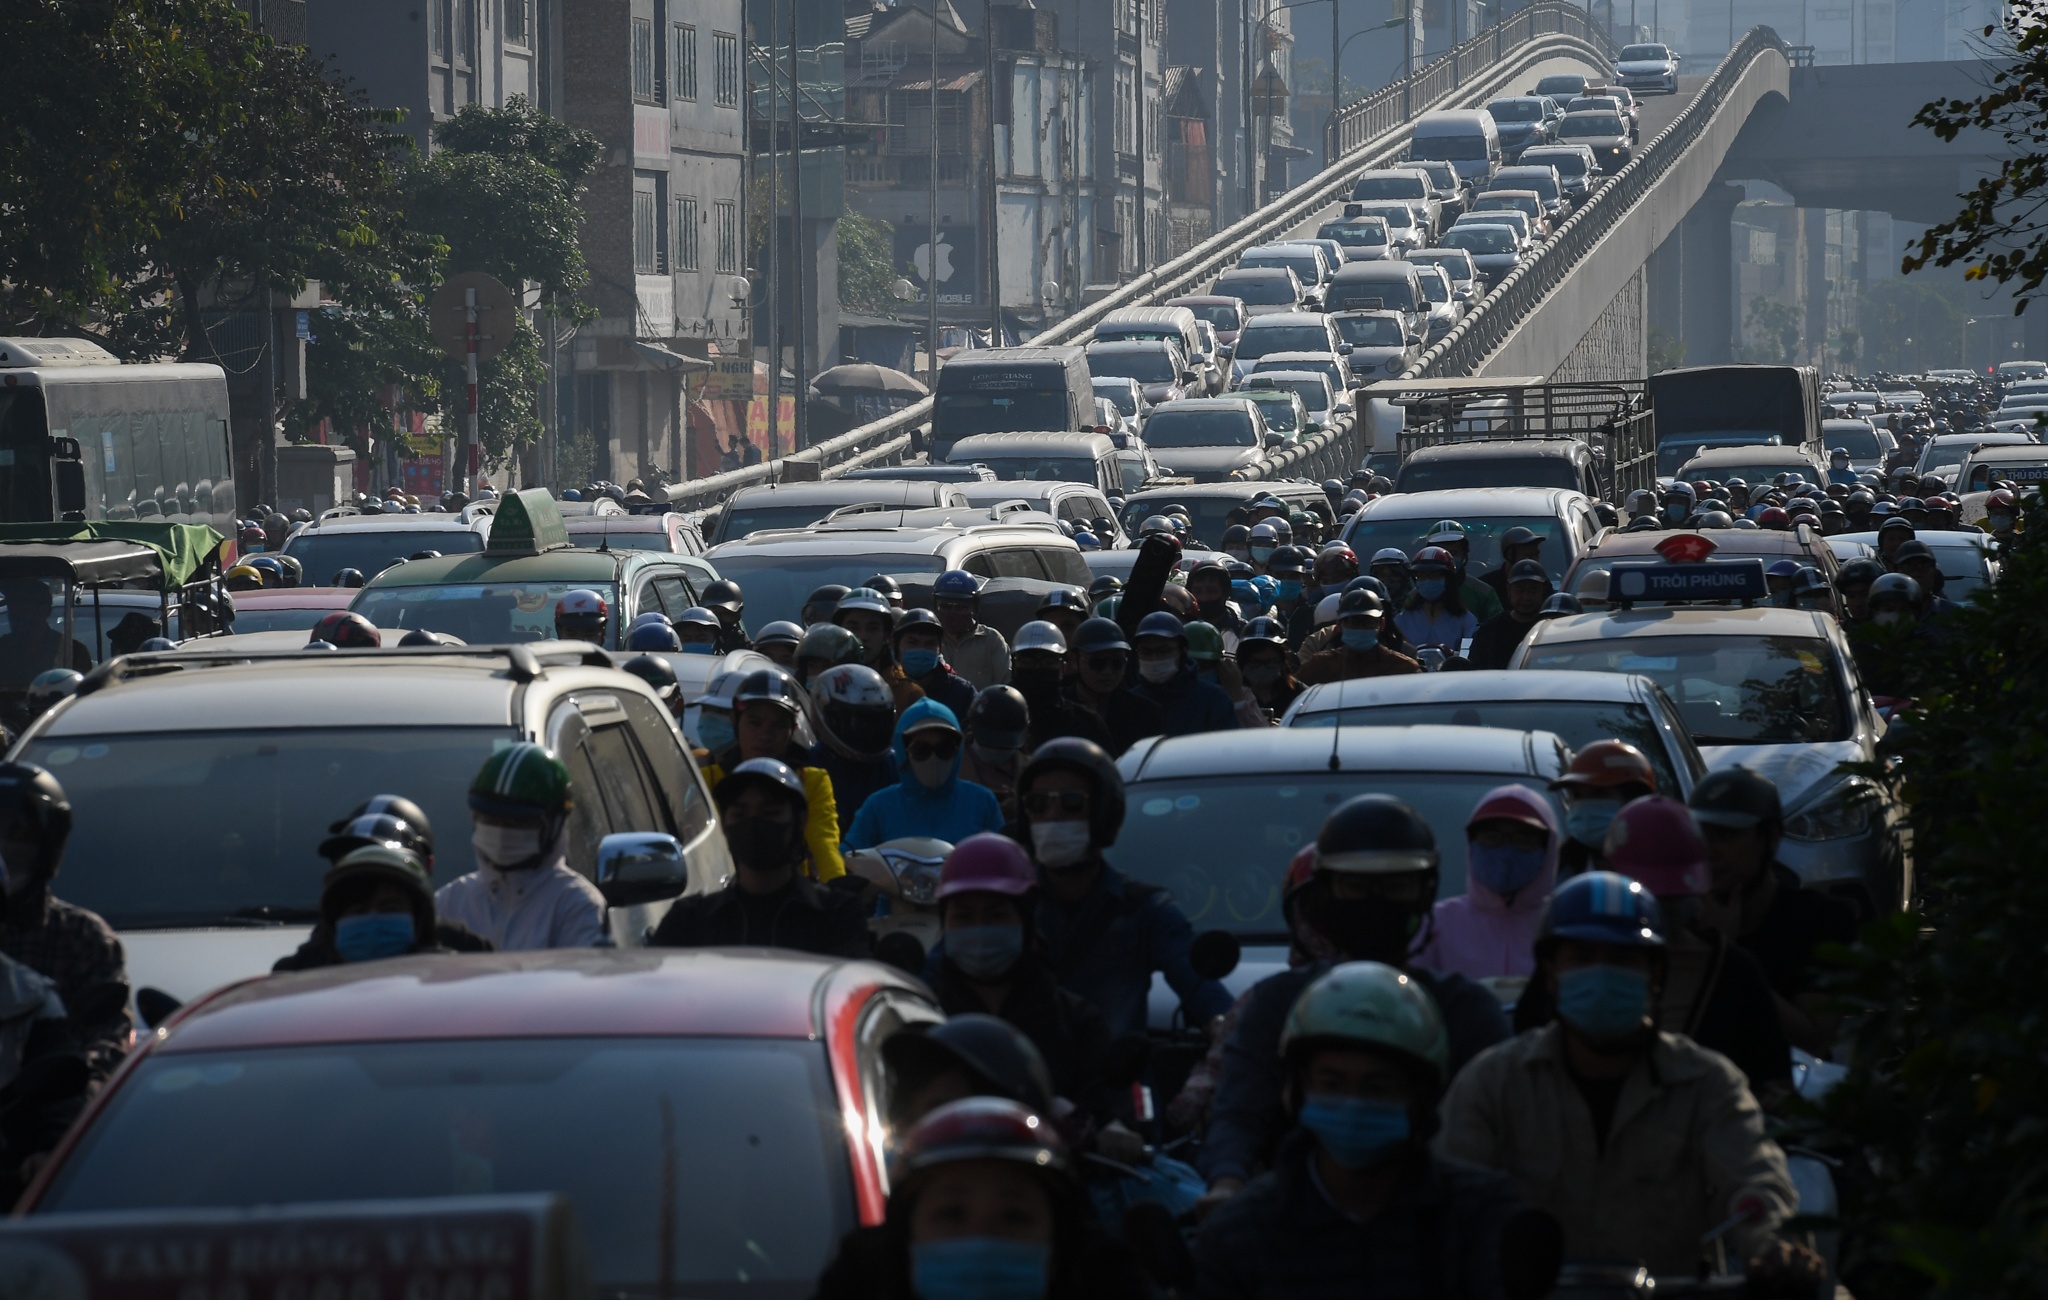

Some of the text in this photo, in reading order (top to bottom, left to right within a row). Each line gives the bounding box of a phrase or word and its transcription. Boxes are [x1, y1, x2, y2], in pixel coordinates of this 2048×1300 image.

[936, 294, 972, 304] MOBILE
[1003, 372, 1032, 381] GIANG
[2006, 470, 2027, 480] THỦ
[2028, 469, 2042, 480] ĐÔ
[1650, 571, 1748, 589] TRÔI PHÙNG
